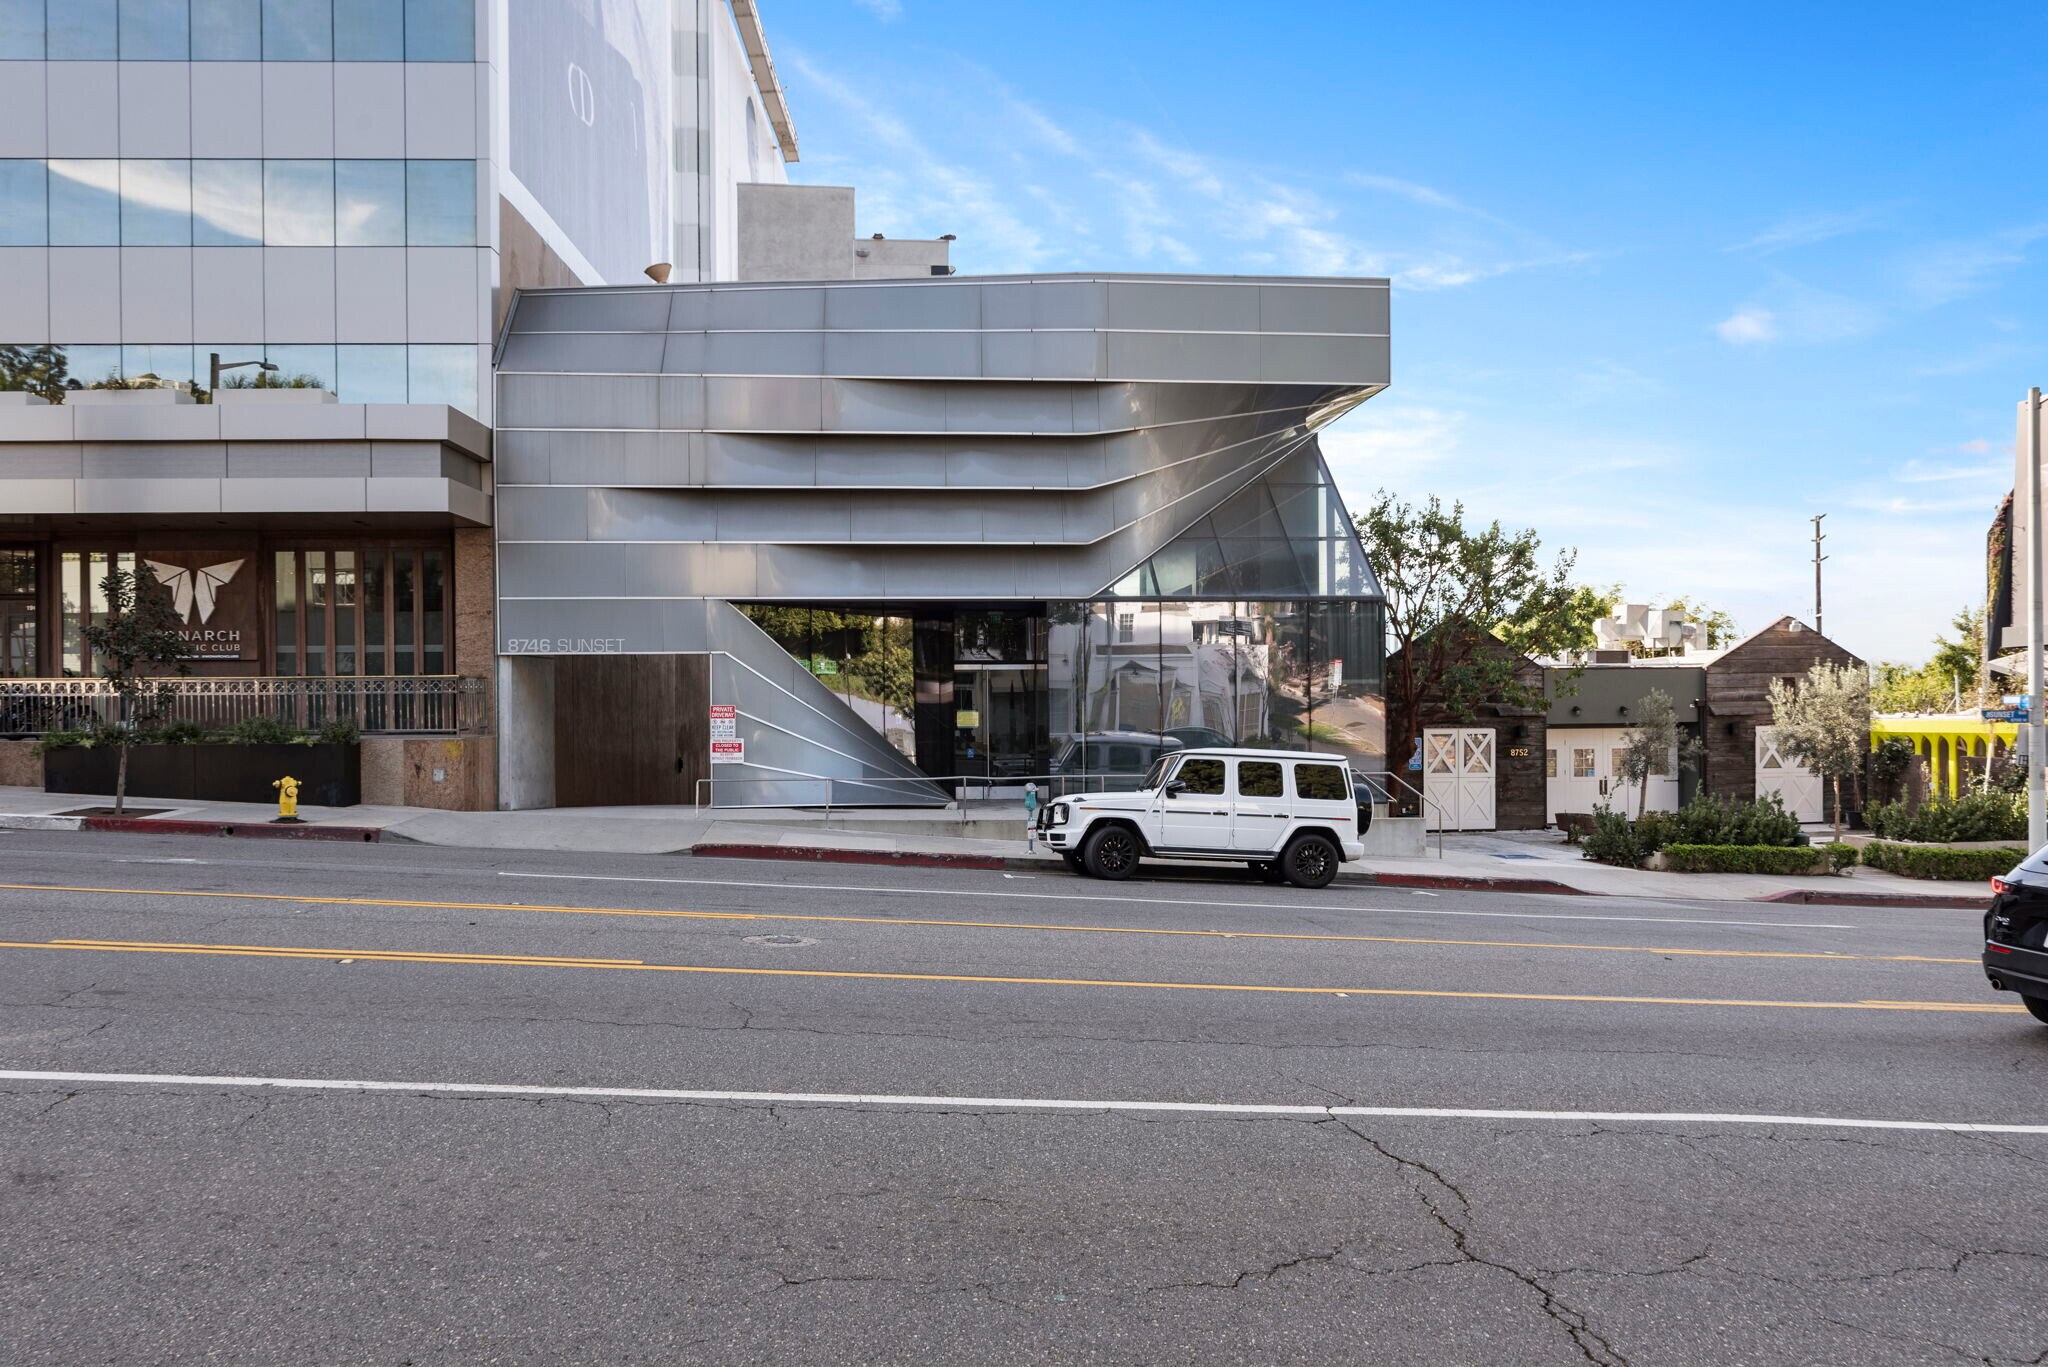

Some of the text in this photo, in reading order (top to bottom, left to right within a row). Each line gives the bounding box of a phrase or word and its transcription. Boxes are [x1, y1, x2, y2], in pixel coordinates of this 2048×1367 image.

[164, 630, 240, 641] NARCH
[508, 638, 625, 652] 8746 SUNSET
